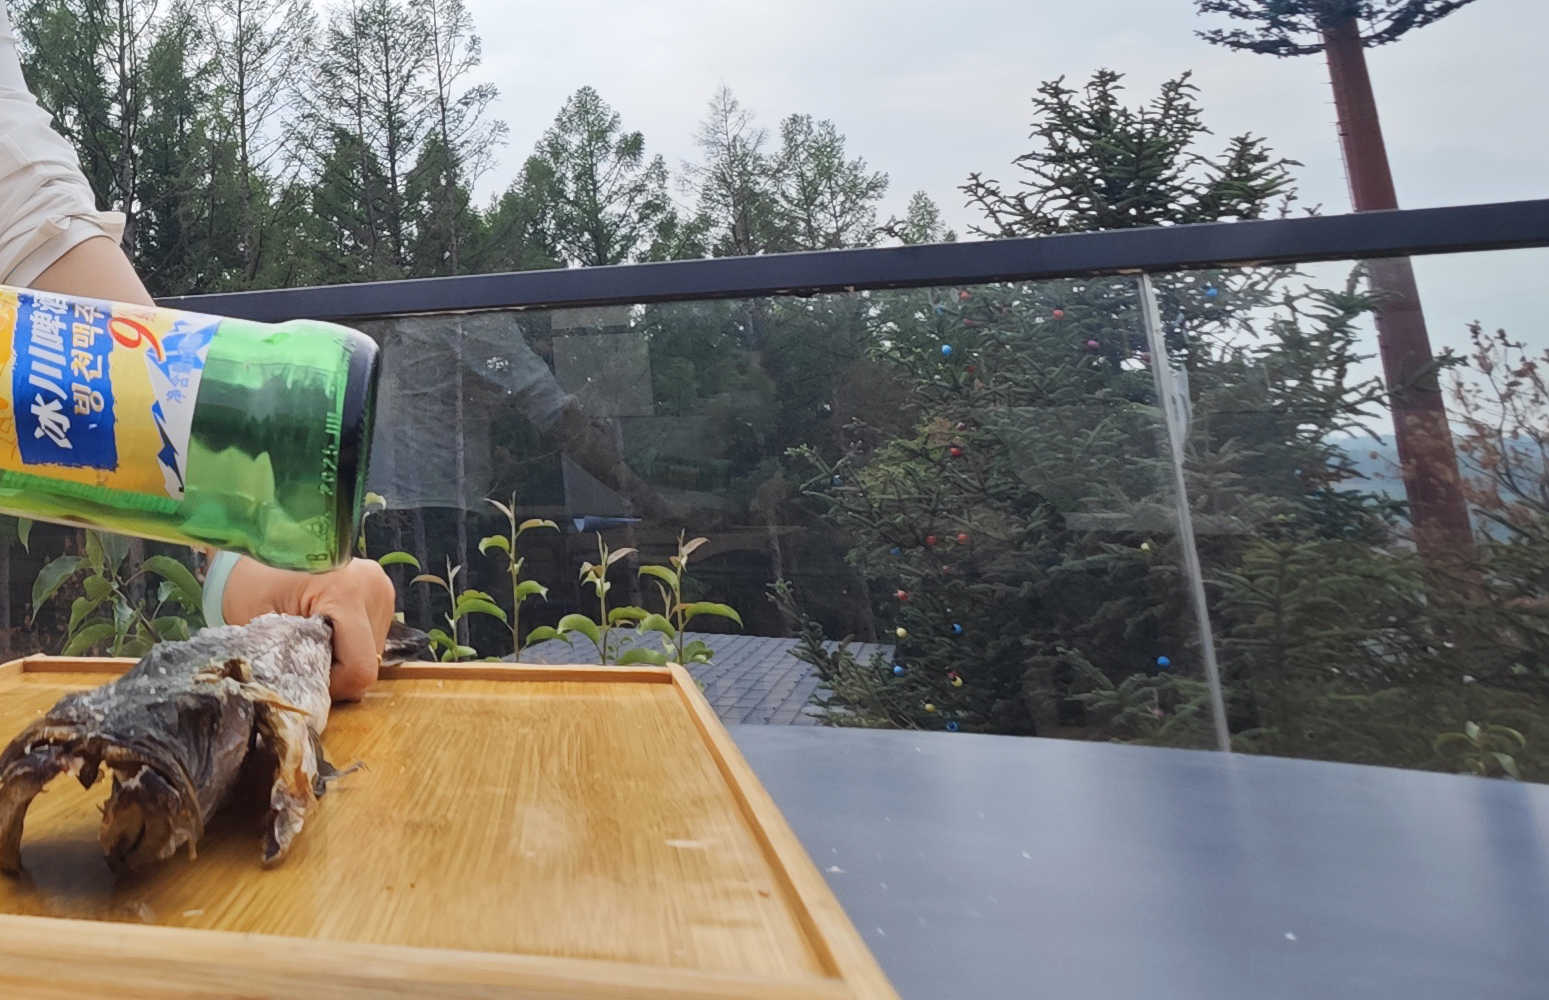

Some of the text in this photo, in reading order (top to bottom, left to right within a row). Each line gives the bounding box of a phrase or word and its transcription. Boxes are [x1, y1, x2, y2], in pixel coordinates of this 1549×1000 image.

[28, 293, 73, 449] 冰川啤酒
[71, 303, 105, 415] 빙천맥주
[108, 317, 166, 363] 9
